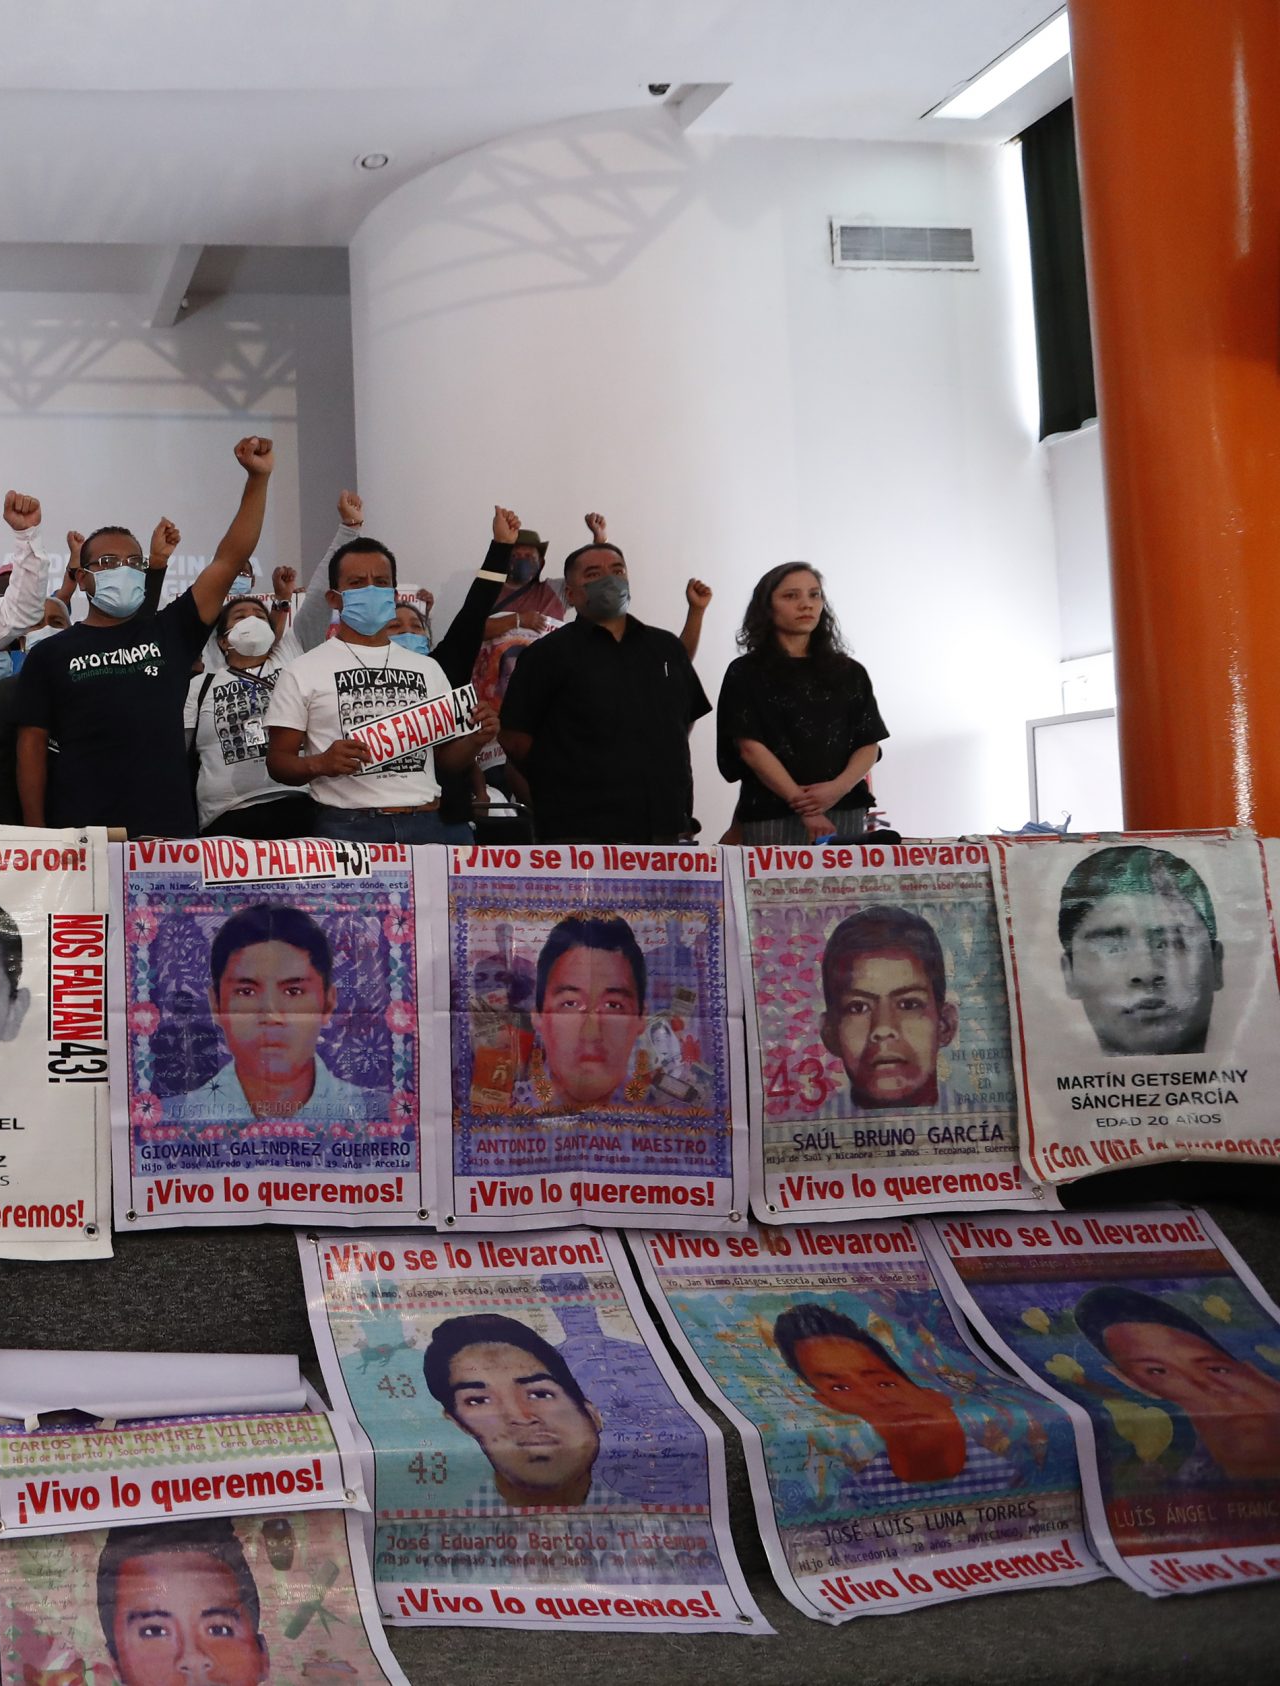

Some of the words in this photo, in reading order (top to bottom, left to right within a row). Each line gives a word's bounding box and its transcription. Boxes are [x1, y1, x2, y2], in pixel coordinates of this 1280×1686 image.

[69, 643, 161, 671] AYOTZINAPA
[144, 665, 158, 676] 43
[337, 669, 425, 689] AYOTZINAPA
[391, 699, 455, 752] FALTAN
[129, 840, 199, 870] ¡Vivo
[202, 840, 249, 878] NOS
[255, 838, 336, 876] FALTAN
[52, 914, 104, 958] NOS
[53, 965, 103, 1040] FALTAN
[48, 1041, 108, 1083] 43!
[767, 1058, 827, 1107] 43
[1057, 1072, 1125, 1090] MARTÍN
[1131, 1070, 1248, 1087] GETSEMANY
[1072, 1093, 1161, 1110] SÁNCHEZ
[1166, 1090, 1239, 1106] GARCÍA
[793, 1128, 841, 1151] SAÚL
[855, 1128, 915, 1147] BRUNO
[928, 1121, 1004, 1144] GARCÍA
[1096, 1117, 1141, 1128] EDAD
[1148, 1116, 1168, 1126] 20
[1176, 1113, 1221, 1124] AÑOS
[141, 1144, 220, 1160] GIOVANNI
[230, 1141, 320, 1156] GALINDREZ
[331, 1142, 410, 1157] GUERRERO
[476, 1138, 546, 1154] ANTONIO
[554, 1135, 621, 1152] SANTANA
[632, 1137, 707, 1154] MAESTRO
[1042, 1142, 1091, 1174] ¡Con
[146, 1178, 214, 1212] ¡Vivo
[224, 1176, 249, 1202] lo
[258, 1176, 404, 1207] queremos!
[470, 1180, 534, 1213] ¡Vivo
[540, 1178, 562, 1203] lo
[570, 1181, 715, 1207] queremos!
[779, 1175, 844, 1209] ¡Vivo
[852, 1173, 877, 1198] lo
[883, 1166, 1023, 1202] queremos!
[649, 1232, 720, 1266] ¡Vivo
[726, 1236, 759, 1257] se
[762, 1230, 792, 1257] lo
[795, 1226, 918, 1256] llevaron!
[943, 1222, 1012, 1256] ¡Vivo
[1020, 1226, 1052, 1247] se
[1051, 1220, 1083, 1246] lo
[1083, 1215, 1205, 1245] llevaron!
[8, 1439, 72, 1452] CARLOS
[83, 1434, 124, 1448] IVÁN
[133, 1430, 206, 1445] RAMÍREZ
[214, 1420, 316, 1438] VILLARREAL
[18, 1480, 100, 1524] ¡Vivo
[110, 1476, 141, 1508] lo
[150, 1459, 325, 1513] queremos!
[822, 1522, 863, 1547] JOSÉ
[924, 1511, 966, 1532] LUNA
[976, 1501, 1038, 1523] TORRES
[385, 1532, 430, 1551] José
[441, 1533, 518, 1551] Eduardo
[528, 1532, 608, 1551] Bartolo
[617, 1532, 707, 1551] Tlatempa
[819, 1575, 900, 1612] ¡Vivo
[892, 1568, 934, 1594] lo
[932, 1539, 1084, 1592] queremos!
[397, 1588, 484, 1617] ¡Vivo
[490, 1590, 526, 1616] lo
[535, 1591, 722, 1620] queremos!
